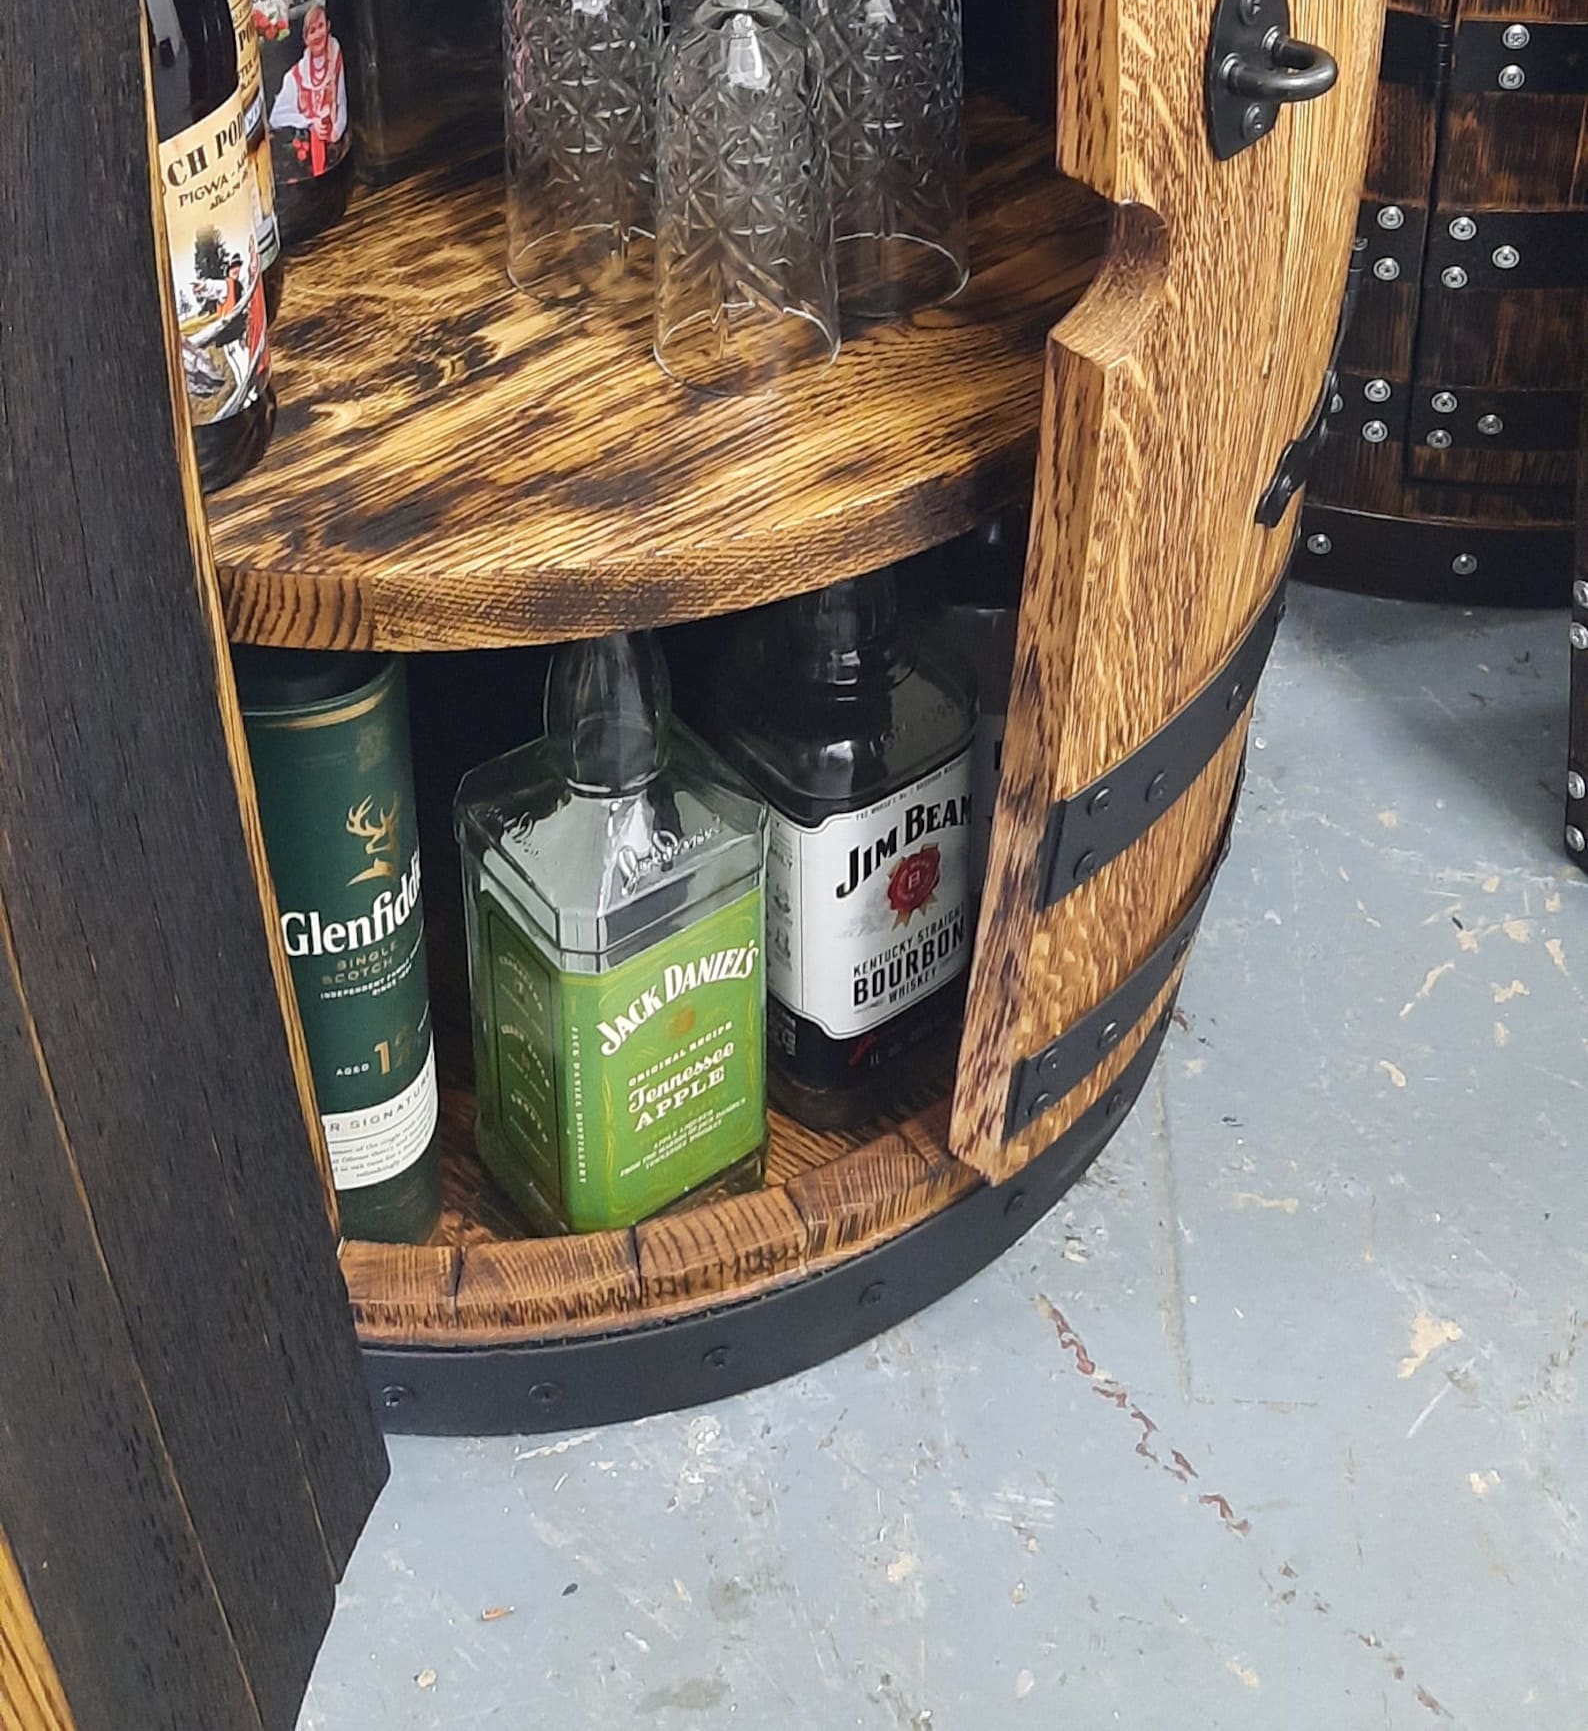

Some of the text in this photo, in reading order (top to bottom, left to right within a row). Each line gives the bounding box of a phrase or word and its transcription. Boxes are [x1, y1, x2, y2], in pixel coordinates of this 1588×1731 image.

[178, 173, 229, 208] PIGWA
[836, 826, 898, 898] JIM
[321, 956, 393, 986] SCOTCH
[337, 939, 398, 970] SINGLE
[853, 935, 913, 978] KENTUCKY
[853, 915, 965, 1007] BOURBON
[320, 977, 384, 1000] INDEPENDENT
[595, 984, 664, 1057] JACK
[663, 939, 759, 1005] DANIEL'S
[888, 966, 937, 1004] WHISKEY
[336, 1063, 370, 1076] AGED
[628, 1021, 732, 1087] ORIGINAL RECIPE
[628, 1042, 735, 1114] Tennessee
[634, 1065, 725, 1132] APPLE
